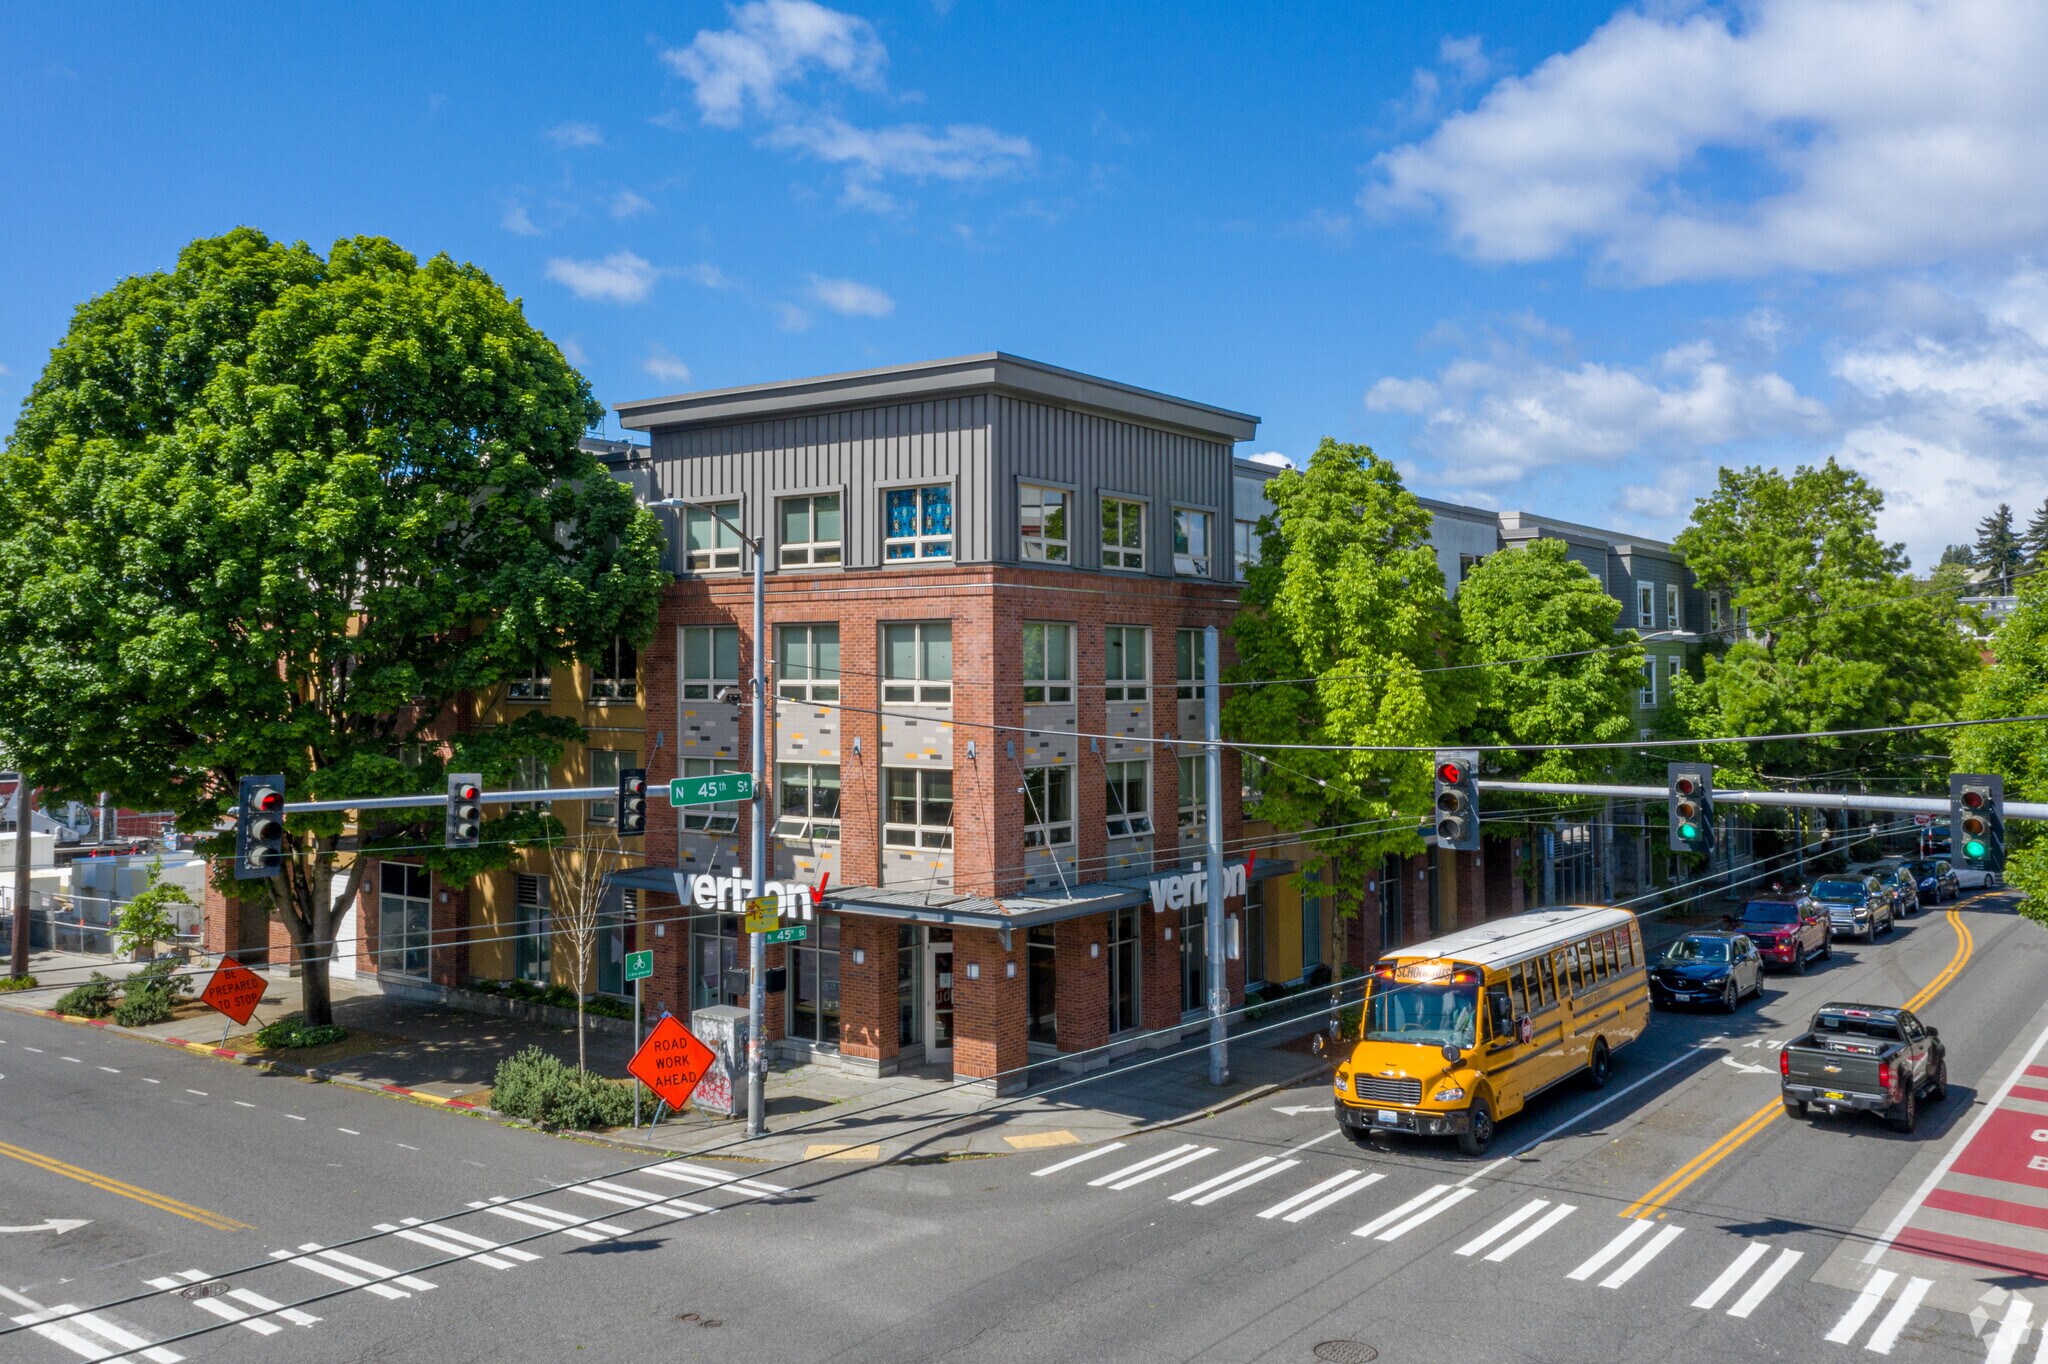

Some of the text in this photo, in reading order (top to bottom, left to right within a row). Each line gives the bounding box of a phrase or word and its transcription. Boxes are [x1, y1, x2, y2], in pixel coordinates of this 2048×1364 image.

[676, 786, 684, 799] N
[697, 781, 727, 797] 45th
[224, 969, 237, 980] BE
[1397, 966, 1432, 979] SCHOO
[209, 979, 258, 998] PREPARED
[218, 993, 257, 1010] TO STOP
[654, 1037, 687, 1052] ROAD
[656, 1055, 690, 1070] WORK
[656, 1071, 697, 1088] AHEAD
